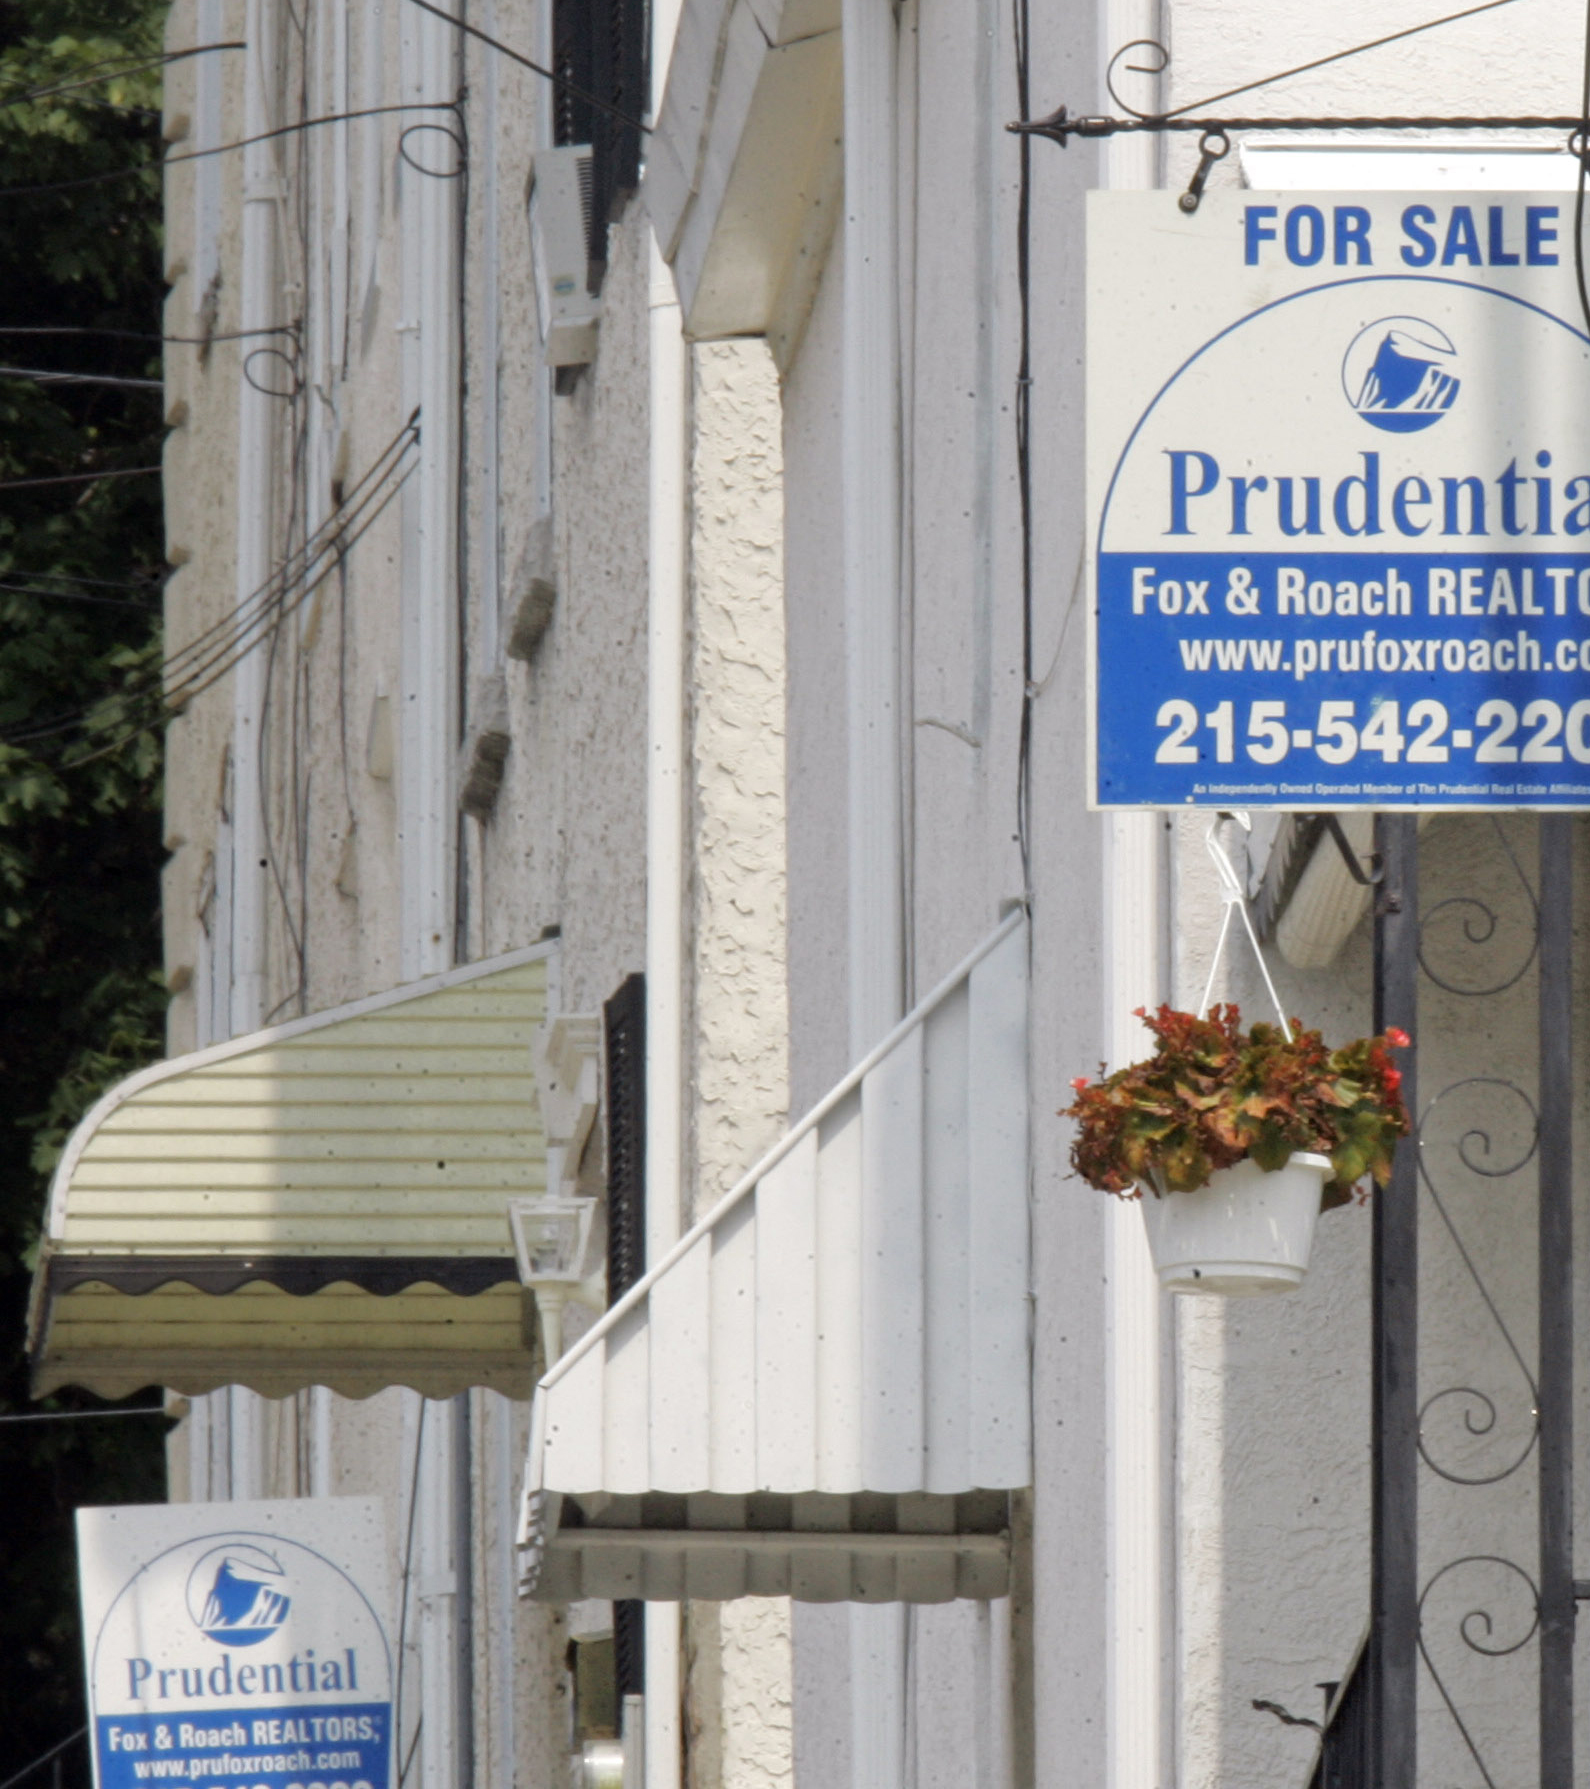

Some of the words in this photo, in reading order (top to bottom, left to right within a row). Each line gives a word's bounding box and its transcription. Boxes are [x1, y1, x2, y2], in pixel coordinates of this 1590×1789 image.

[1246, 206, 1372, 267] FOR
[1400, 205, 1559, 267] SALE
[1133, 567, 1209, 615] Fox
[1226, 567, 1260, 615] &
[1278, 568, 1411, 616] Roach
[1418, 783, 1437, 794] The
[126, 1648, 358, 1700] Prudential
[108, 1726, 149, 1752] Fox
[154, 1724, 174, 1750] &
[179, 1721, 247, 1749] Roach
[133, 1750, 361, 1781] www.prufoxroach.com
